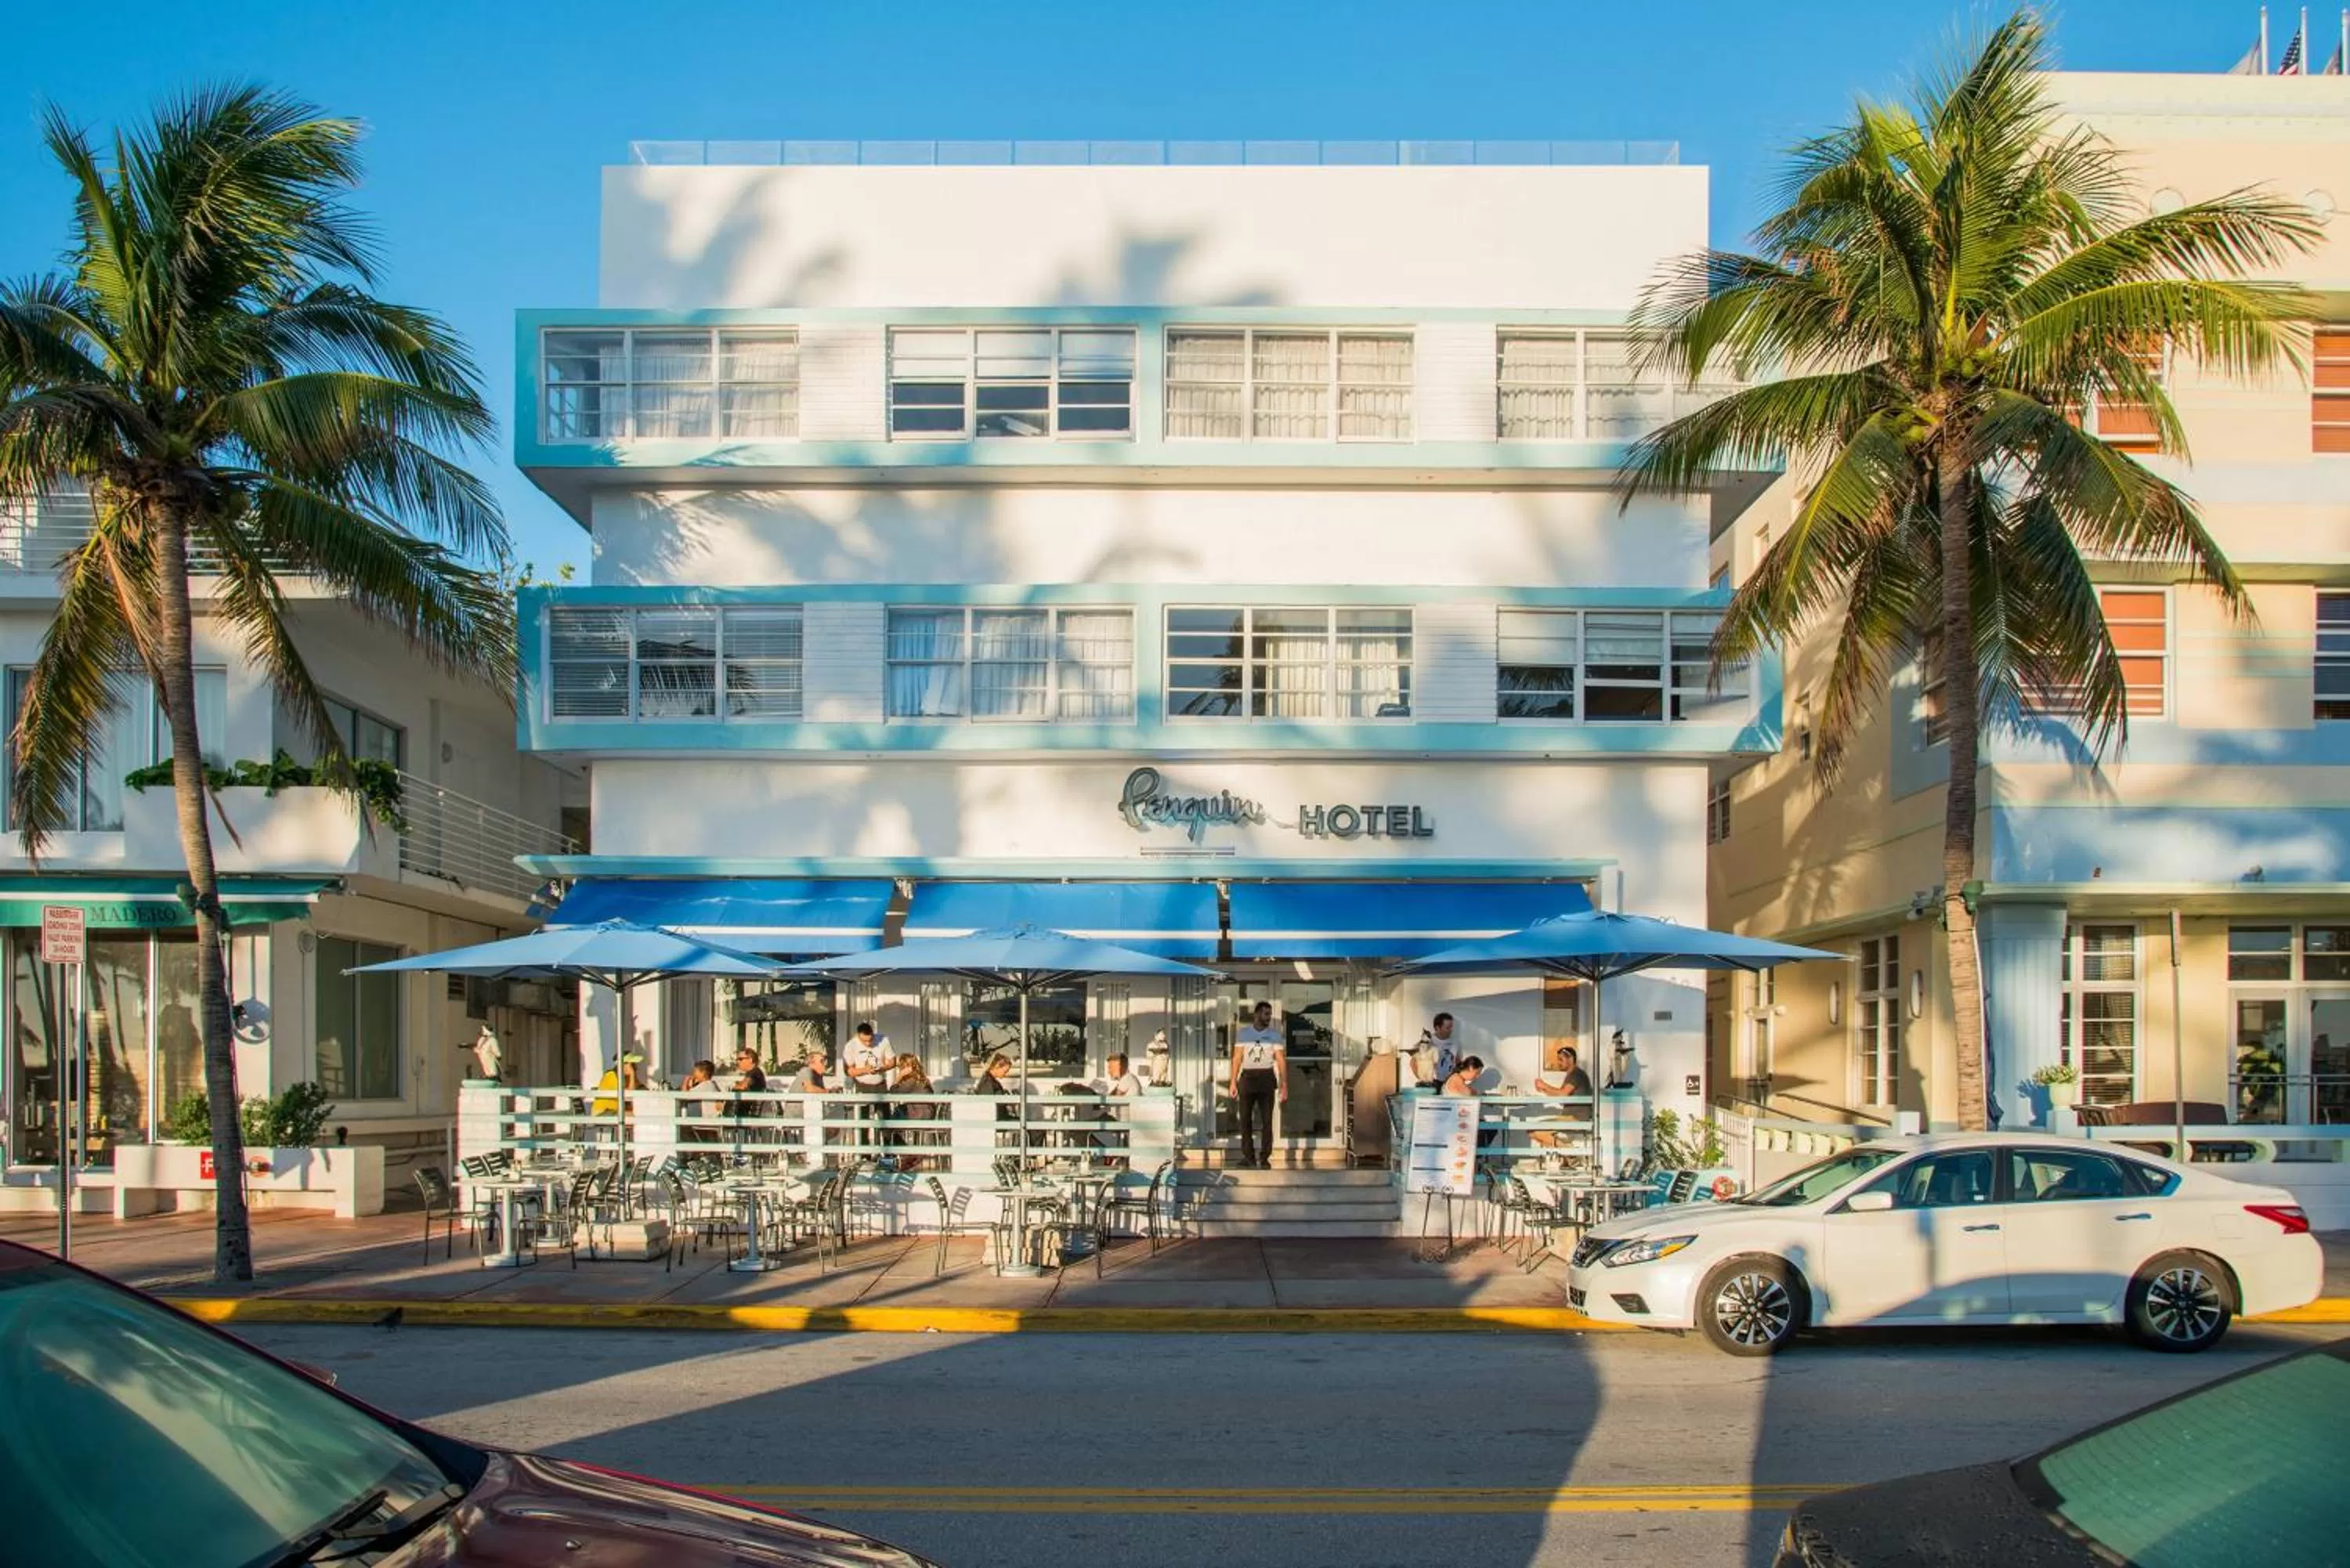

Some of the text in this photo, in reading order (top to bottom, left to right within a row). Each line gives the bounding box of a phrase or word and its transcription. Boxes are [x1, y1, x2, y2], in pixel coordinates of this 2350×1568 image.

[1118, 767, 1434, 842] Penguin HOTEL
[90, 906, 176, 924] MADERO
